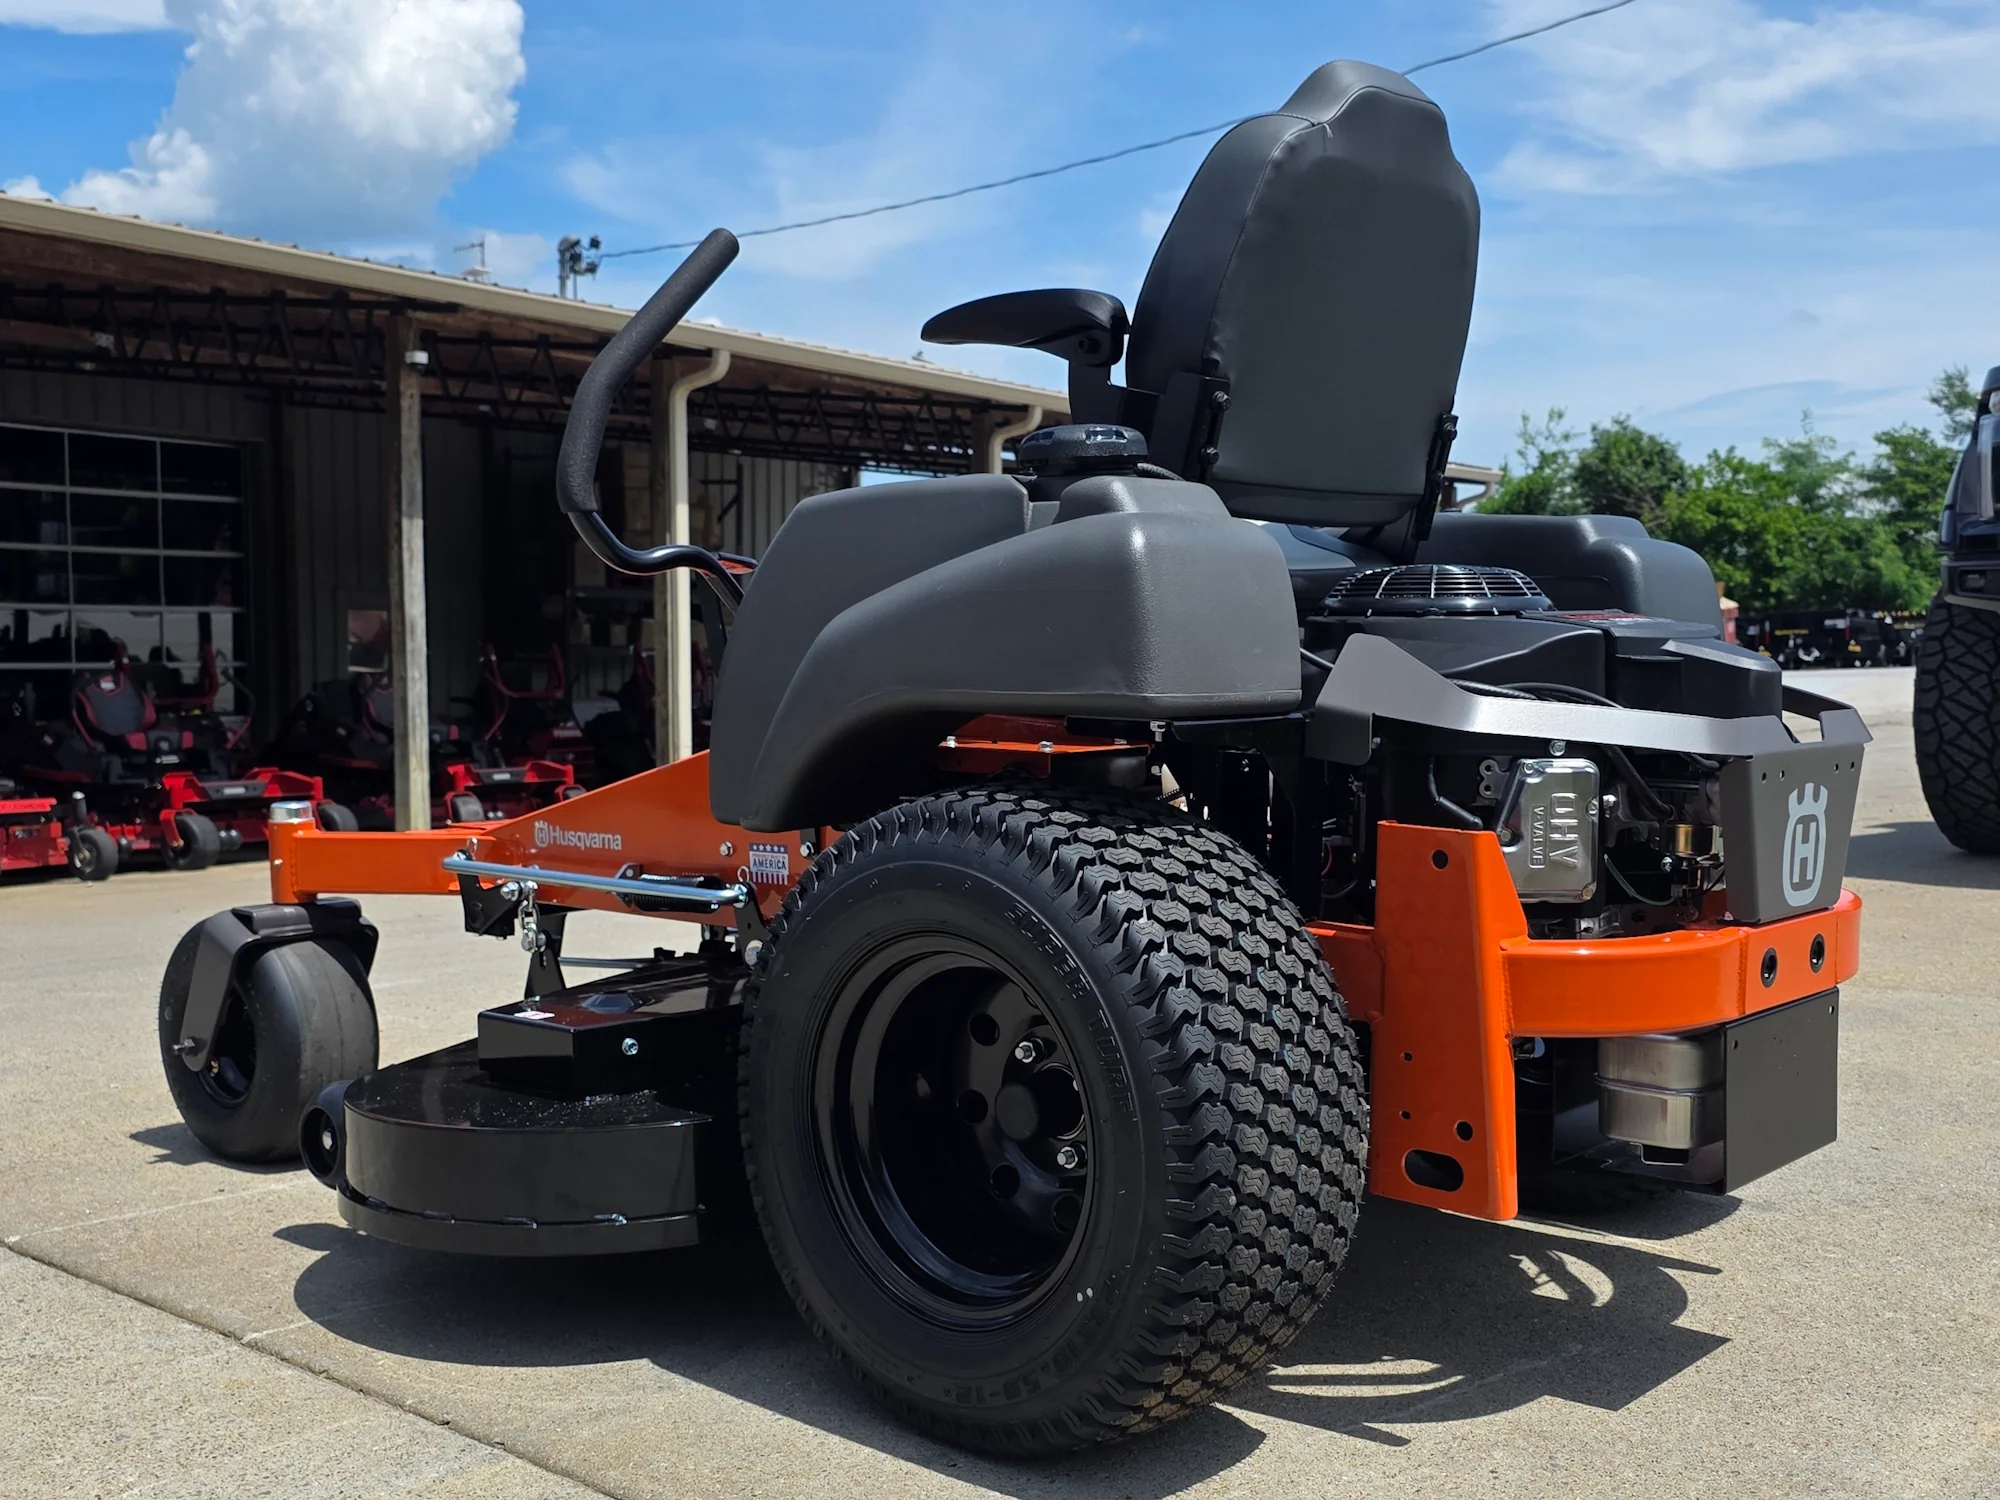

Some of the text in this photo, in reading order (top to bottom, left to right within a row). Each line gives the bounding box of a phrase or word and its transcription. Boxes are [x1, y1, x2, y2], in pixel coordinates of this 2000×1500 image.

[549, 824, 622, 851] Husqvarna
[1532, 806, 1545, 864] V-VALVE
[1549, 791, 1579, 869] OHV
[753, 858, 787, 870] AMERICA
